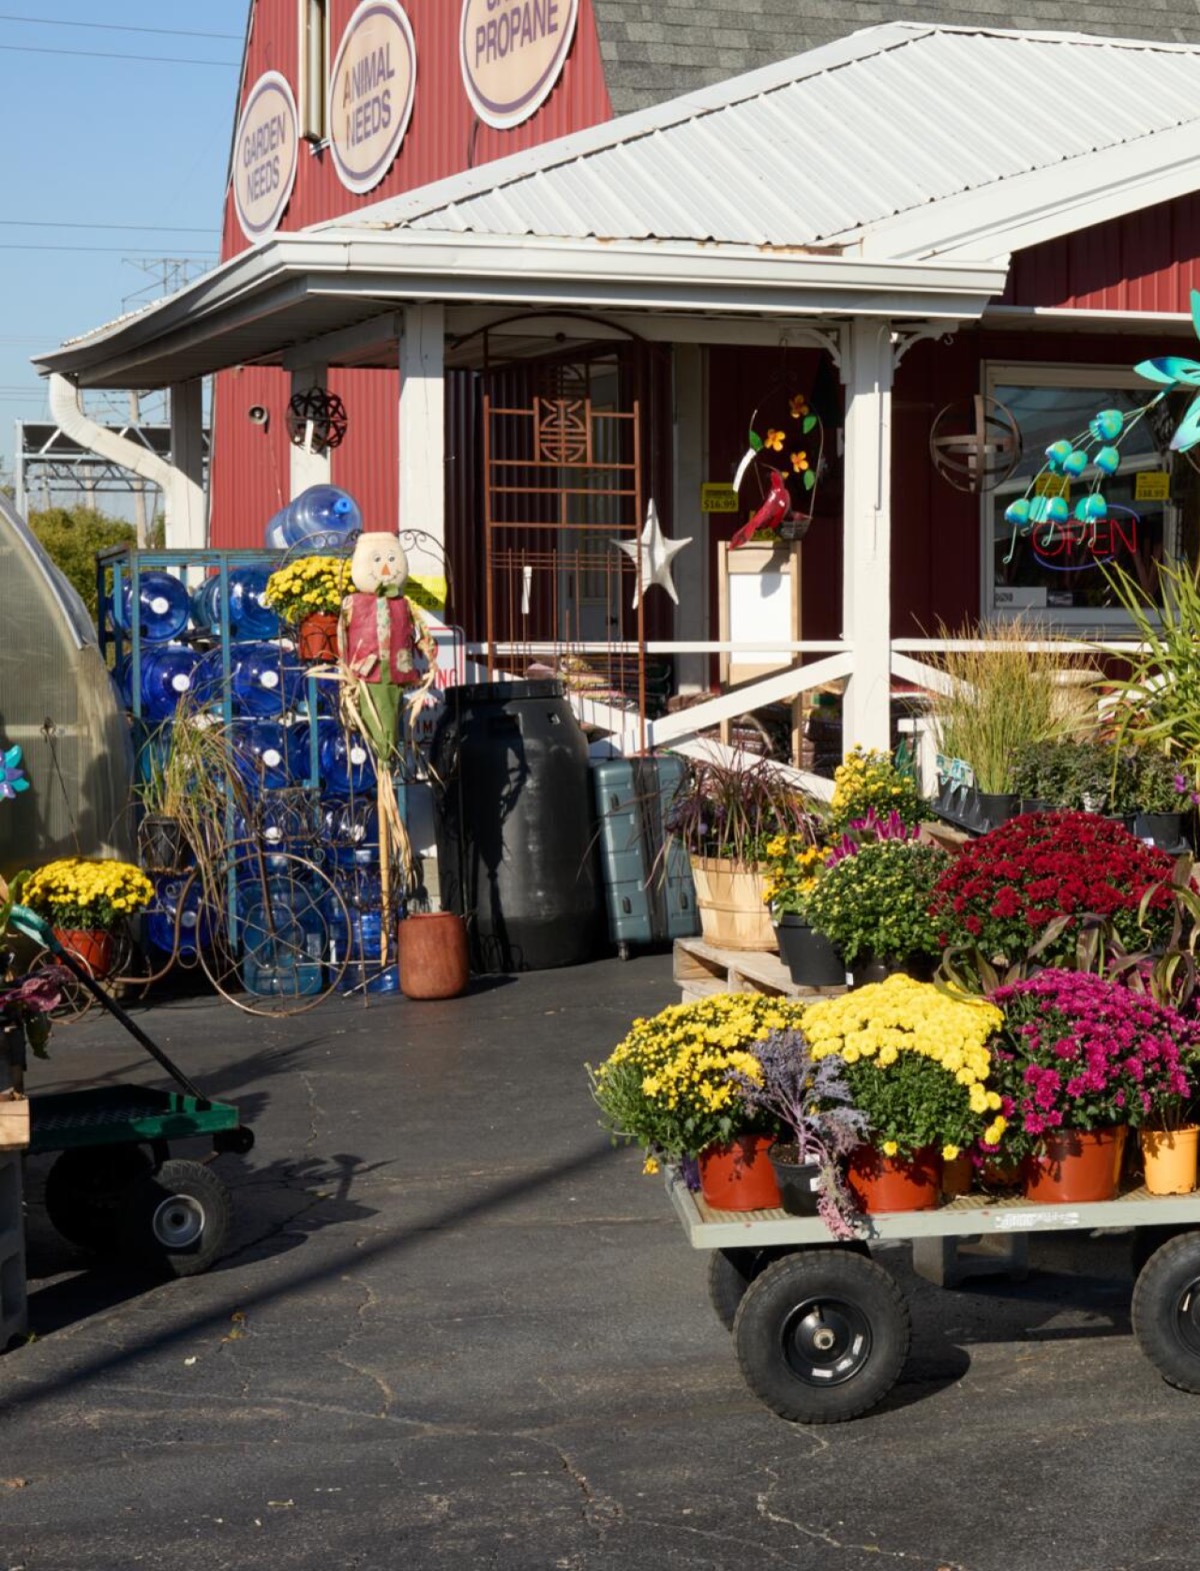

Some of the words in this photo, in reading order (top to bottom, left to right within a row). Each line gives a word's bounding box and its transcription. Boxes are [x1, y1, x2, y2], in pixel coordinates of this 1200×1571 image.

[475, 0, 558, 69] PROPANE
[342, 42, 395, 108] ANIMAL
[242, 111, 286, 165] GARDEN
[346, 94, 392, 151] NEEDS
[246, 155, 280, 206] NEEDS
[1031, 518, 1138, 557] OPEN
